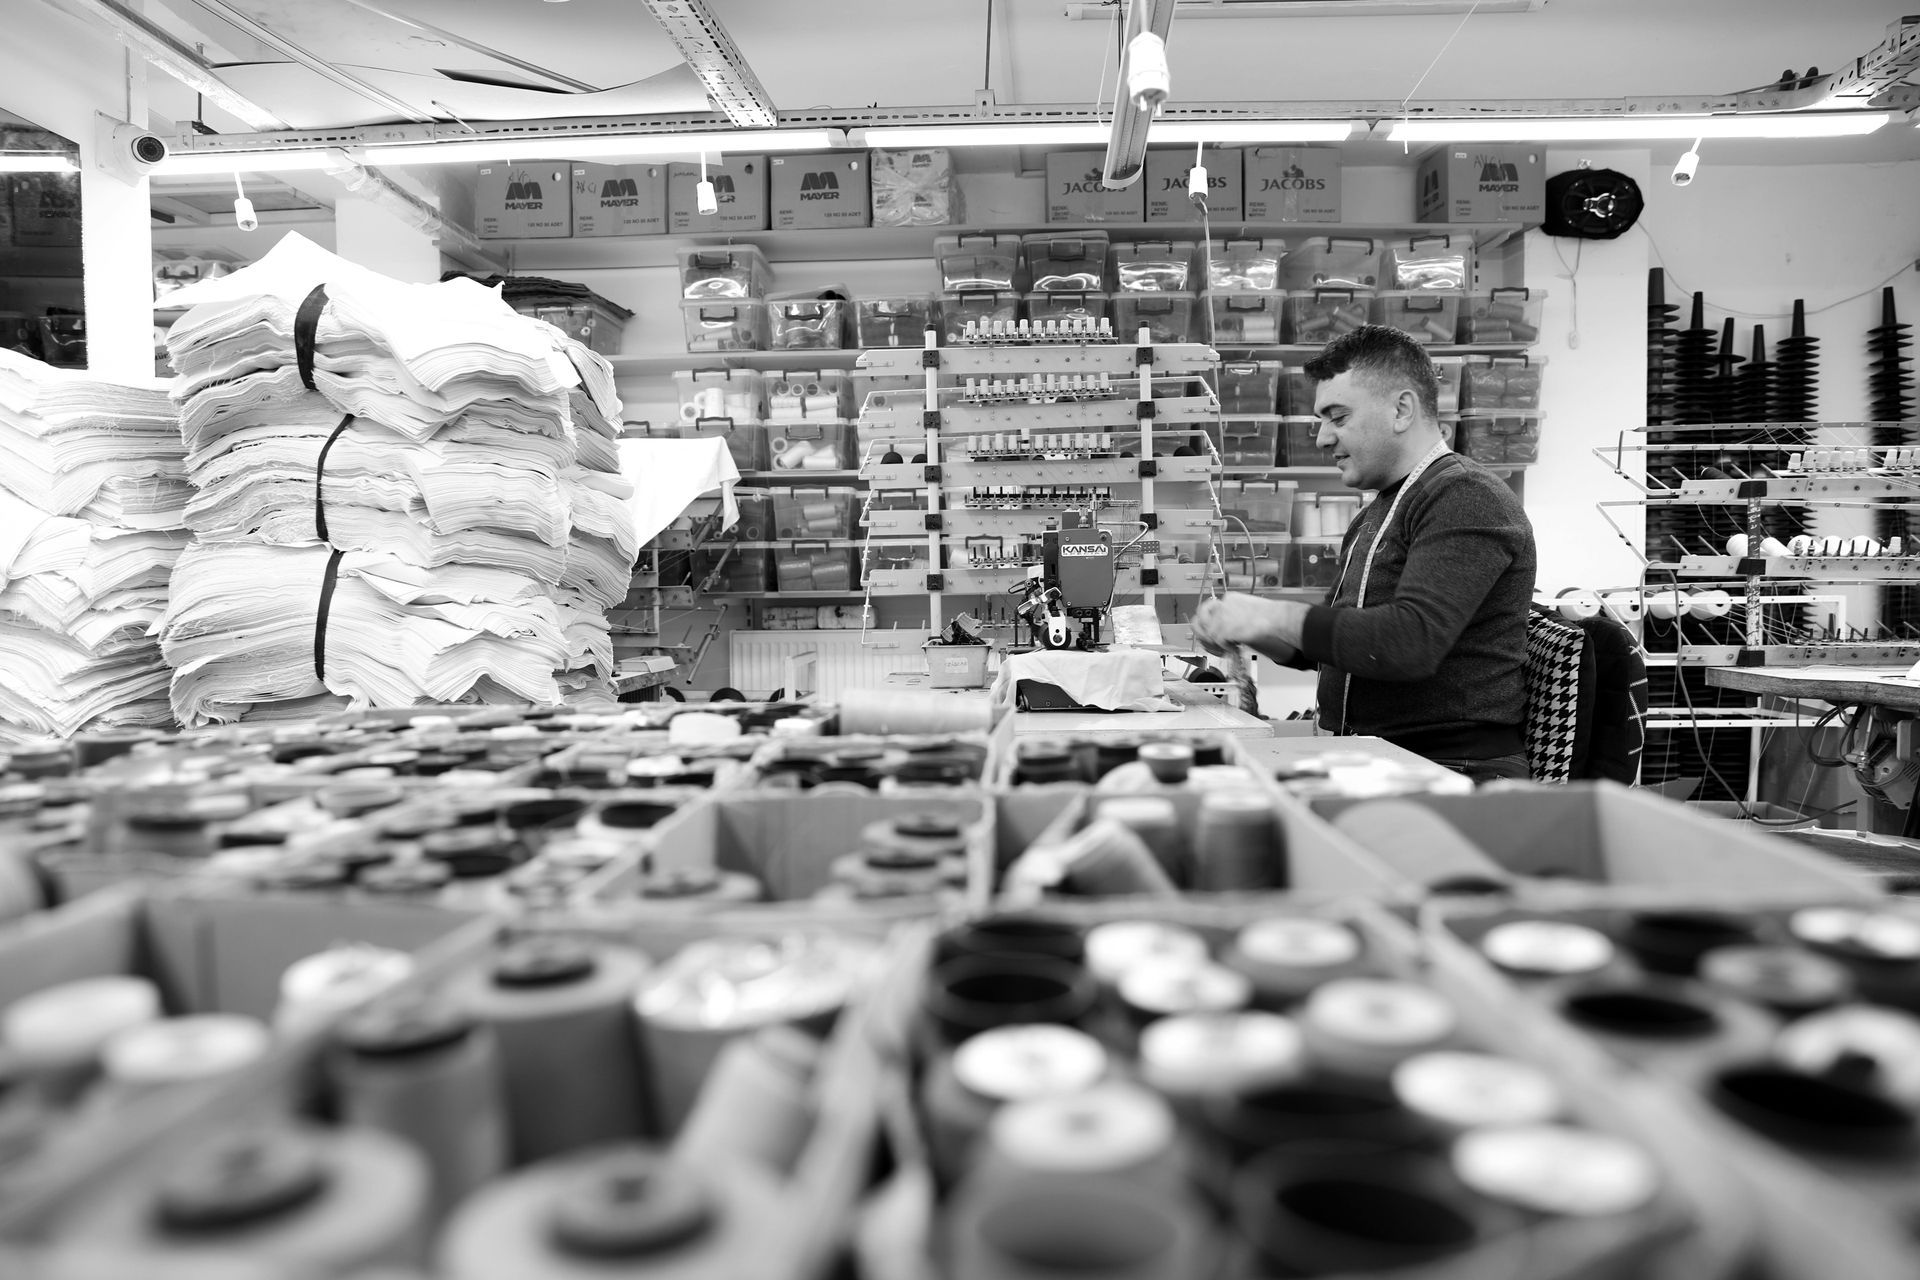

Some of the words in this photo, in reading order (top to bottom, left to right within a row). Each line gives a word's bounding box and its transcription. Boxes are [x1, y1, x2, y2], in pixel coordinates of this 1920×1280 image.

[1062, 181, 1127, 195] JACO
[1161, 177, 1227, 191] JACBS
[1260, 178, 1325, 192] JACOBS
[1479, 184, 1519, 192] MAYER
[800, 191, 840, 201] MAYER
[505, 202, 543, 210] MAYER
[600, 198, 639, 208] MAYER
